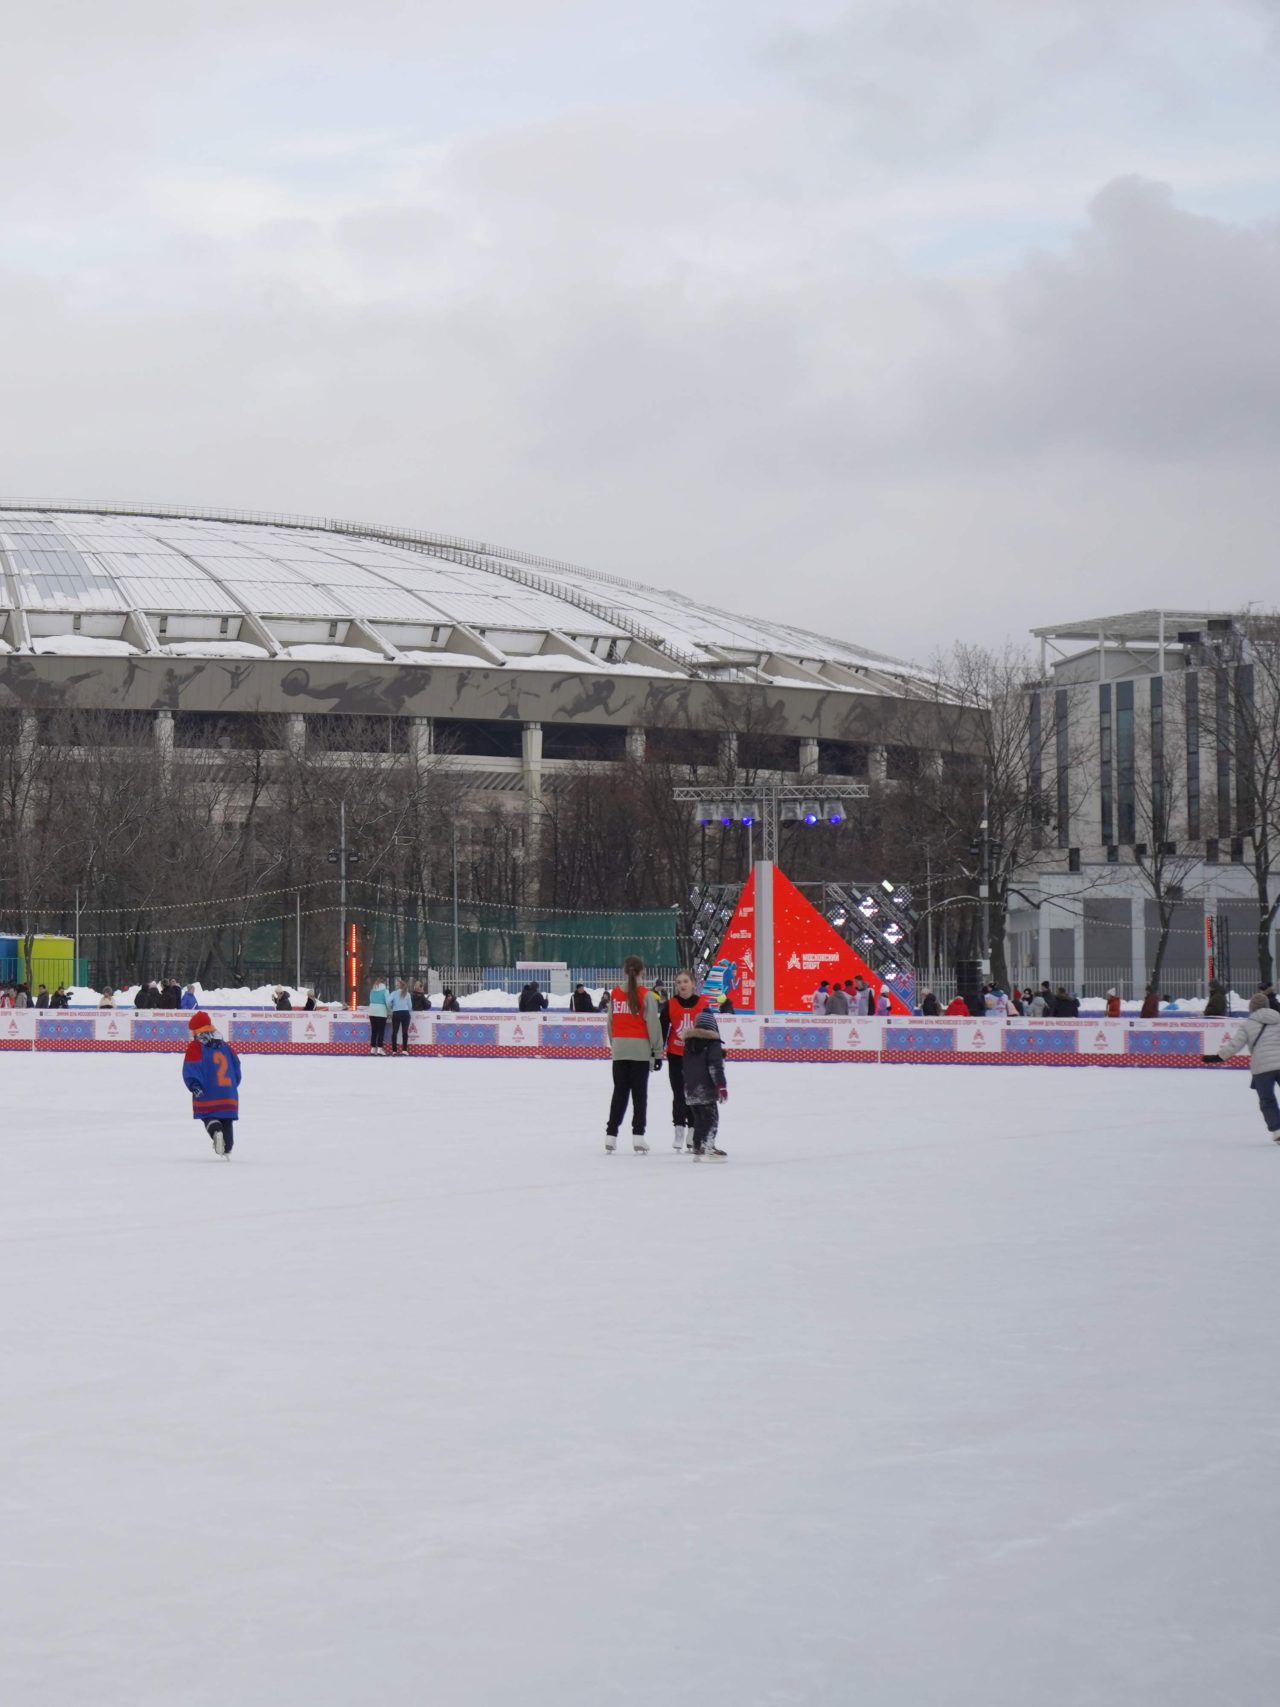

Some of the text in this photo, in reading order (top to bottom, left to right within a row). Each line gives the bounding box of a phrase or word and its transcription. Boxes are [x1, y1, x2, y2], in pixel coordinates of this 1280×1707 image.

[802, 952, 839, 962] МОСКОВСКИЙ
[802, 961, 820, 970] СПОРТ
[213, 1051, 232, 1087] 2
